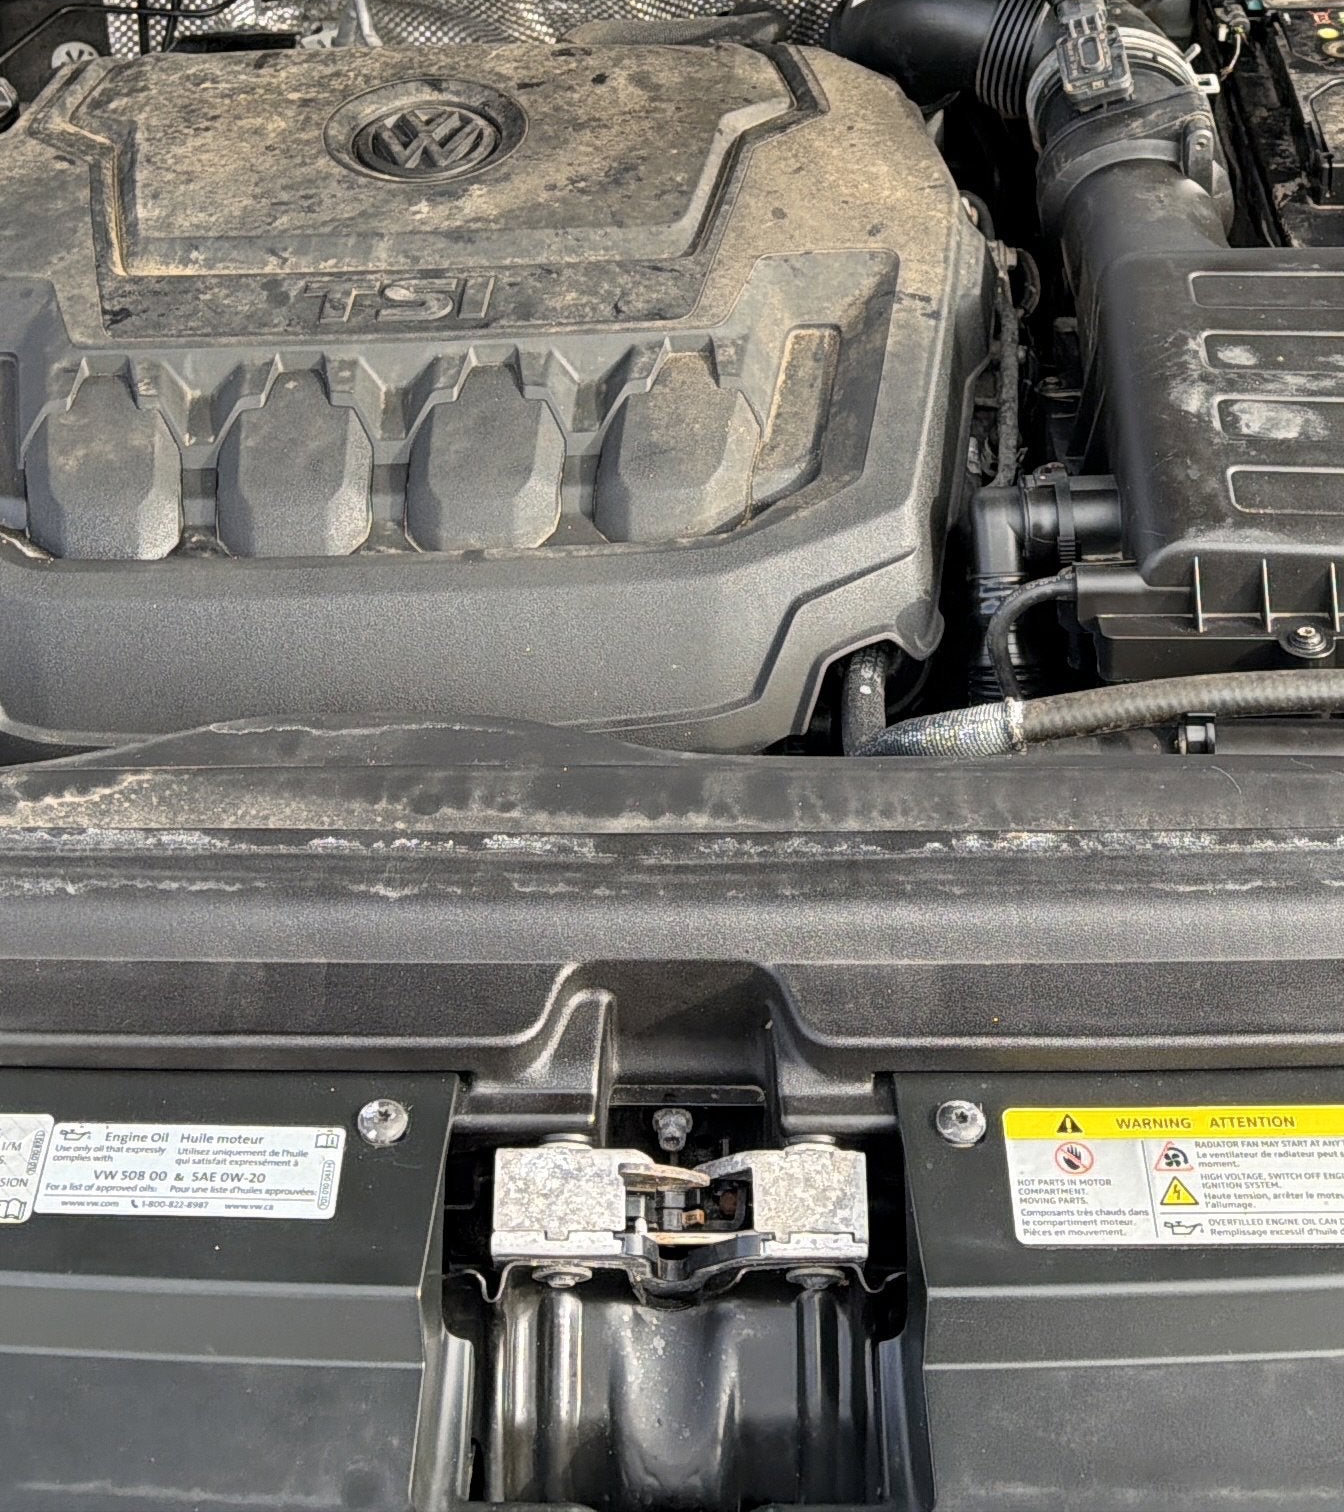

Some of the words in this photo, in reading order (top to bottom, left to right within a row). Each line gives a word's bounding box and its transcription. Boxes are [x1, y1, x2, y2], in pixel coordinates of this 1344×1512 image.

[304, 275, 497, 324] TSI
[1116, 1118, 1192, 1130] WARNING
[1210, 1116, 1295, 1128] ATTENTION
[105, 1132, 148, 1144] Engine
[151, 1132, 170, 1143] Oil
[180, 1133, 214, 1144] Huile
[216, 1135, 264, 1145] moteur
[55, 1144, 72, 1152] Use
[73, 1144, 92, 1154] only
[93, 1145, 104, 1153] oil
[126, 1146, 167, 1156] expressly
[177, 1148, 210, 1156] Utilisez
[212, 1149, 266, 1158] uniquement
[268, 1150, 280, 1158] de
[282, 1150, 309, 1158] l'huile
[1196, 1151, 1207, 1159] Le
[1260, 1150, 1272, 1158] de
[1317, 1151, 1338, 1159] peut
[53, 1154, 91, 1163] complies
[176, 1157, 190, 1166] qui
[192, 1157, 226, 1166] satisfait
[229, 1158, 291, 1167] expressément
[94, 1170, 118, 1180] VW
[120, 1170, 146, 1180] 508
[149, 1171, 168, 1181] 00
[174, 1172, 184, 1182] &
[192, 1172, 216, 1182] SAE
[220, 1172, 266, 1184] 0W-20
[1018, 1178, 1036, 1186] HOT
[1038, 1178, 1066, 1186] PARTS
[1225, 1173, 1267, 1182] VOLTAGE,
[1268, 1172, 1302, 1180] SWITCH
[45, 1182, 58, 1191] For
[69, 1183, 83, 1191] list
[96, 1184, 136, 1194] approved
[170, 1185, 190, 1194] Pour
[210, 1186, 228, 1194] liste
[229, 1186, 263, 1195] d'huiles
[1018, 1188, 1088, 1196] COMPARTMENT.
[1020, 1197, 1056, 1205] MOVING
[1058, 1197, 1088, 1205] PARTS.
[1234, 1192, 1271, 1202] tension,
[1272, 1192, 1304, 1200] arrêter
[142, 1200, 208, 1208] 1-800-822-8987
[1206, 1201, 1256, 1210] l'allumage.
[1021, 1208, 1074, 1218] Composants
[1078, 1208, 1094, 1216] très
[1095, 1208, 1126, 1216] chauds
[1128, 1208, 1150, 1216] dans
[1032, 1218, 1098, 1228] compartiment
[1208, 1218, 1264, 1226] OVERFILLED
[1266, 1218, 1299, 1226] ENGINE
[1318, 1218, 1338, 1226] CAN
[1024, 1228, 1052, 1236] Pièces
[1210, 1228, 1268, 1237] Remplissage
[1270, 1228, 1305, 1236] excessif
[1307, 1228, 1338, 1236] d'huile
